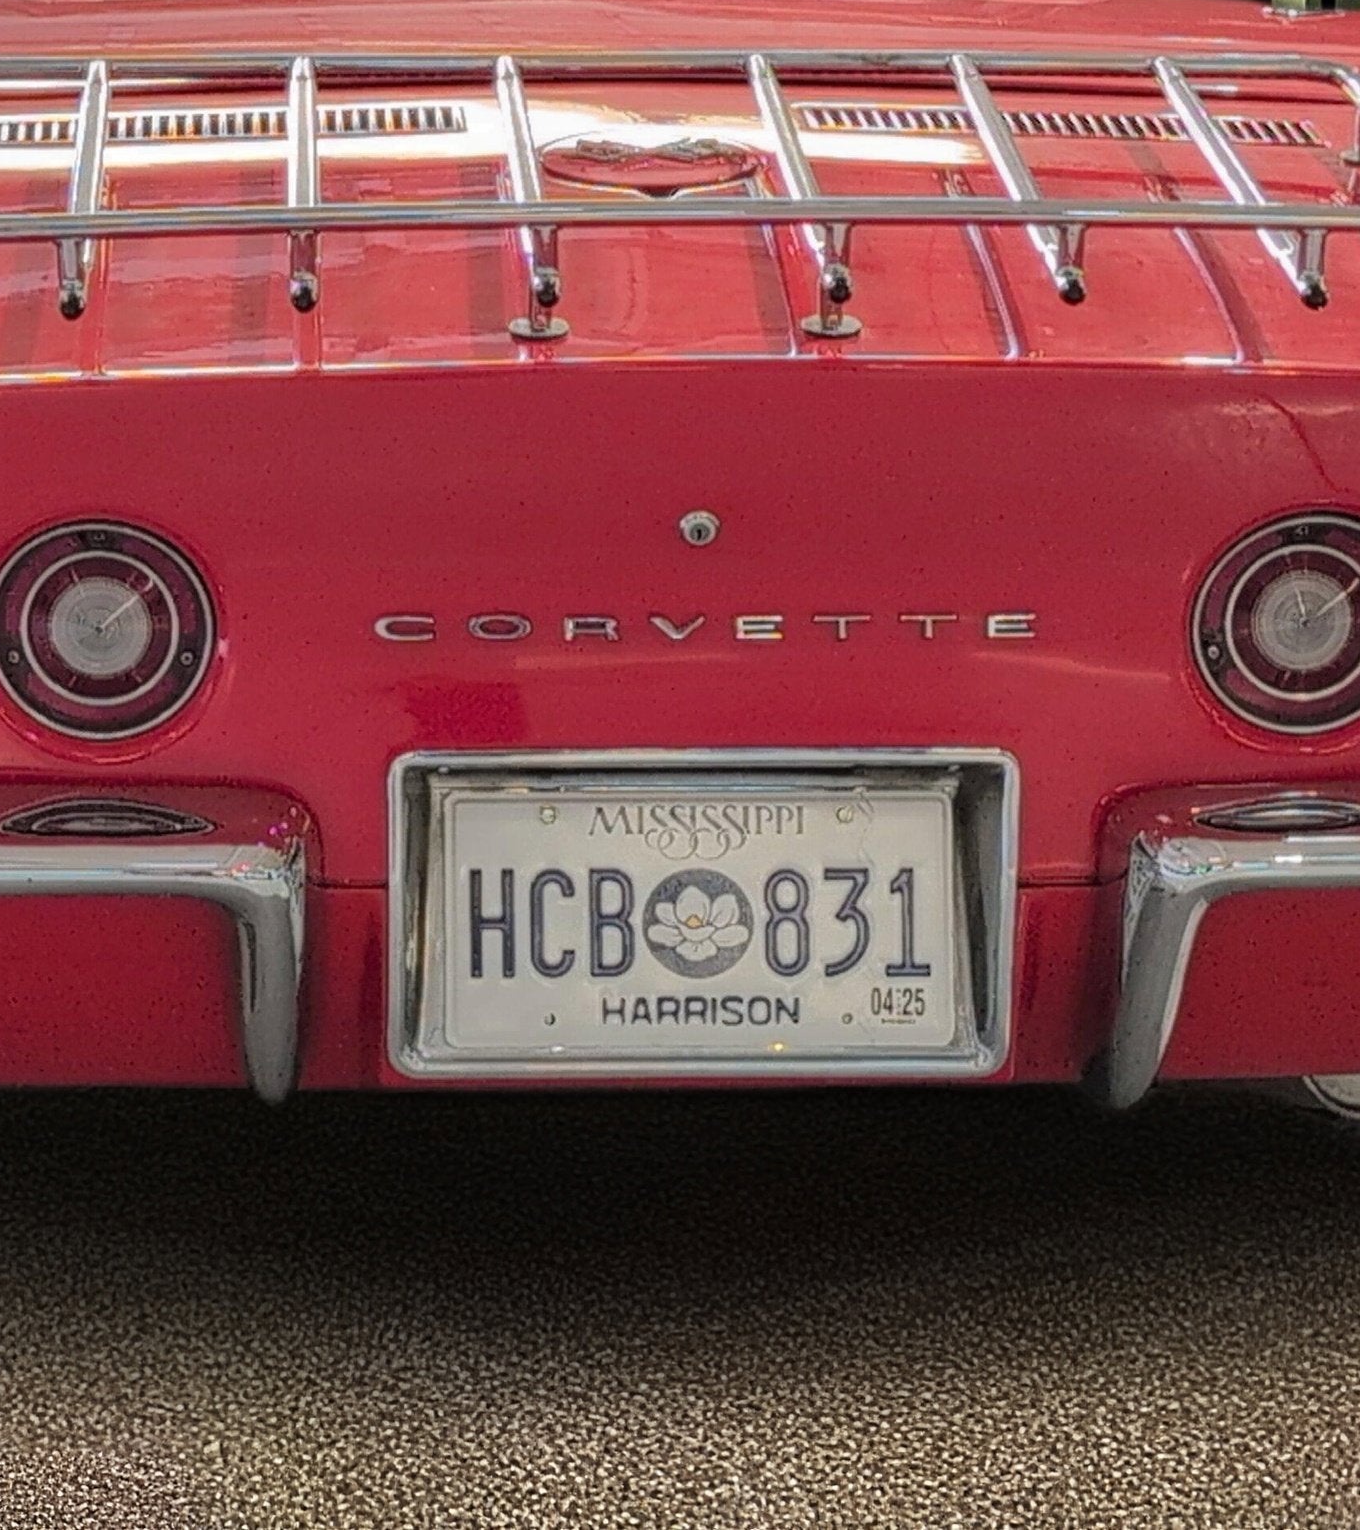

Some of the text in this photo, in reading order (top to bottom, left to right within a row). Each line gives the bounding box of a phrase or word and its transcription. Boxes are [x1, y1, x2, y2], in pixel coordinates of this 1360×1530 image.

[372, 613, 1037, 642] CORVETTE
[588, 803, 805, 861] MISSISSIPPI
[468, 868, 931, 978] HCB 831
[601, 996, 801, 1026] HARRISON
[870, 986, 893, 1016] 04
[902, 986, 926, 1016] 25
